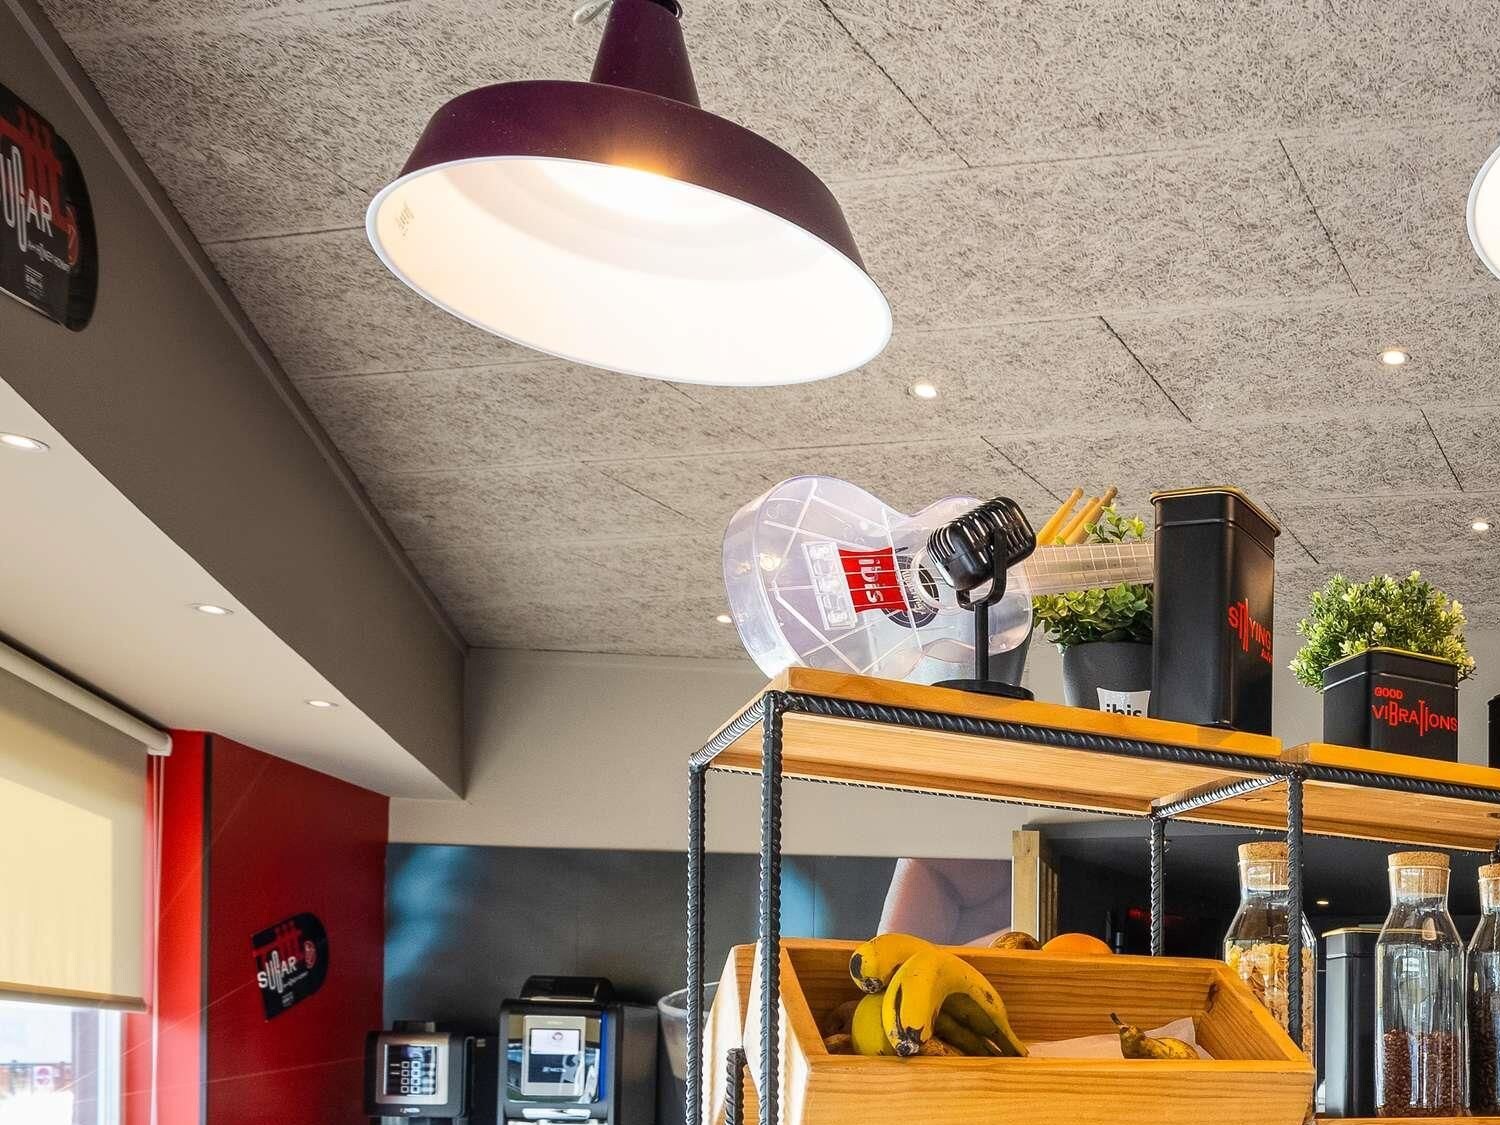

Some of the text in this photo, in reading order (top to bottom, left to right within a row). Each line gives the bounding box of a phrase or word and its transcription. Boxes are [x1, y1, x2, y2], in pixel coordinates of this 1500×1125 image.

[1228, 598, 1272, 652] STAYING
[1374, 686, 1403, 700] GOOD
[1371, 699, 1458, 737] VIBRATIONS
[257, 950, 298, 993] SUGAR
